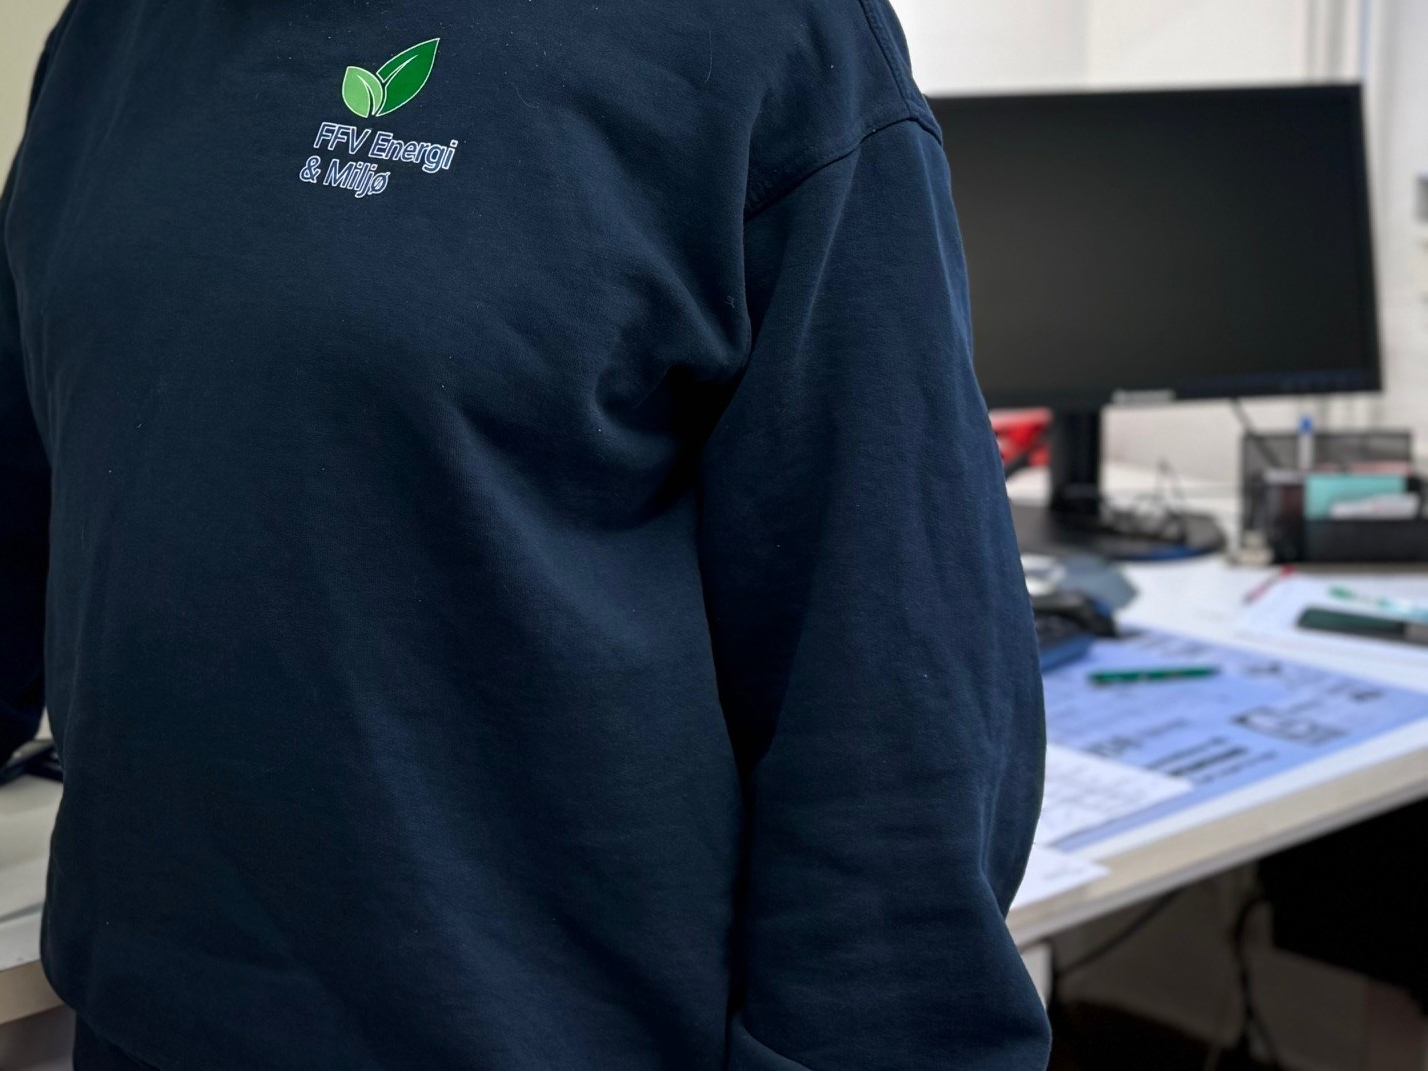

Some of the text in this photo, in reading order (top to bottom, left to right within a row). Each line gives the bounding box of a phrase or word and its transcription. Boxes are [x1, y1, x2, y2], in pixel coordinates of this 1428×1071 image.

[313, 122, 458, 173] FFV Energi
[299, 156, 391, 198] & Miljø
